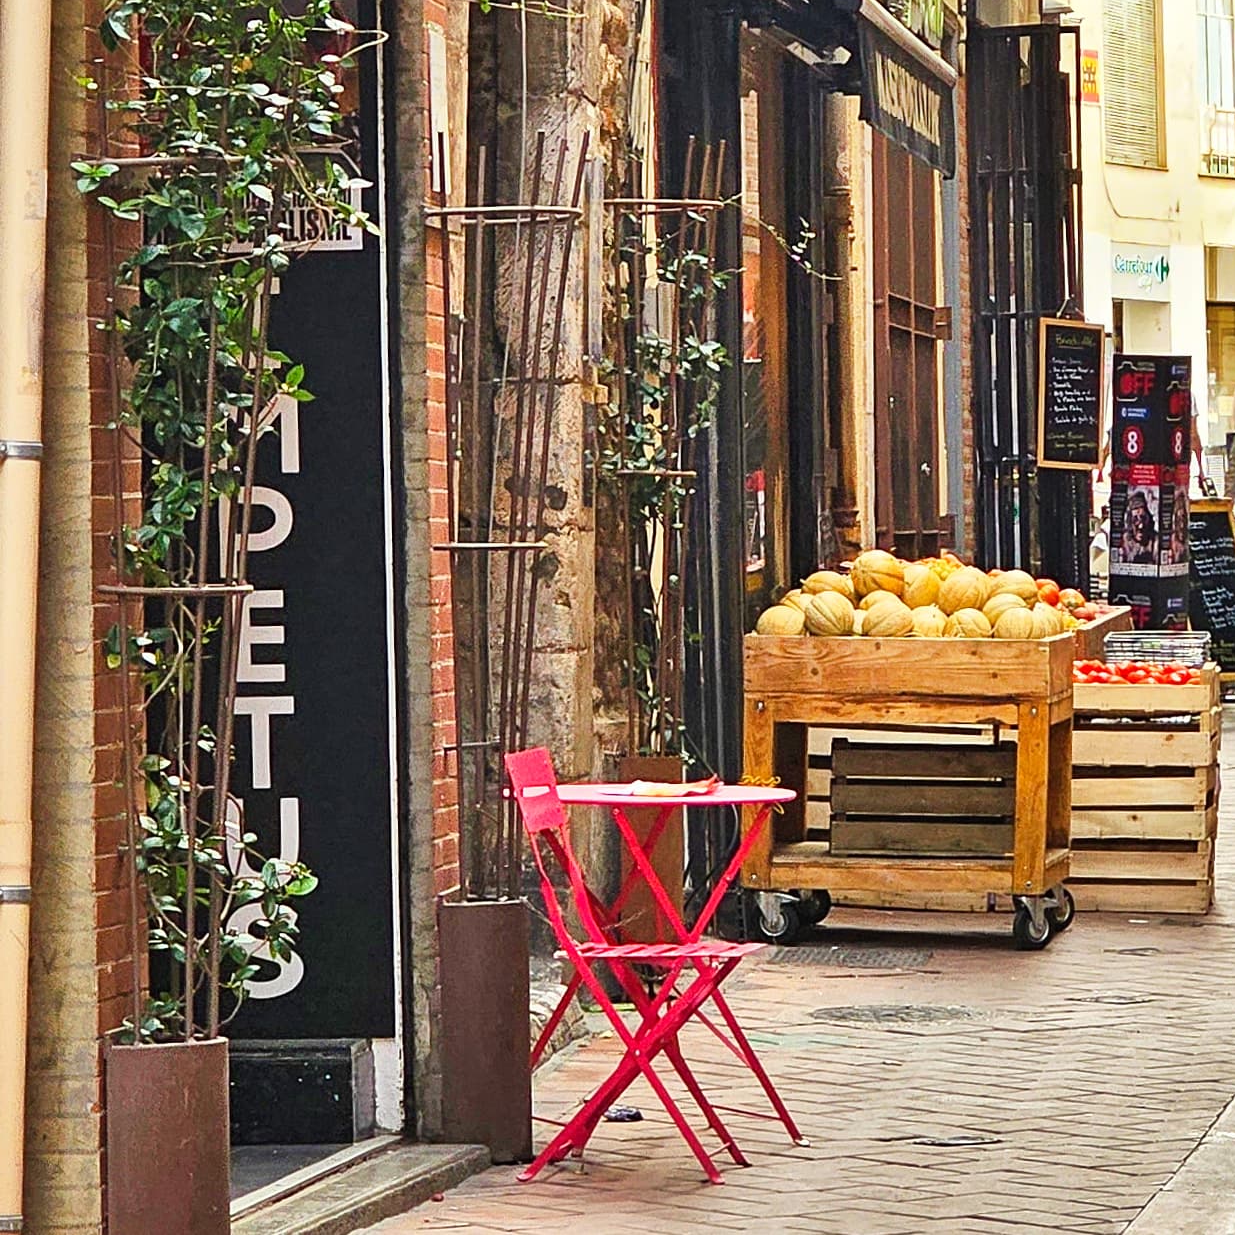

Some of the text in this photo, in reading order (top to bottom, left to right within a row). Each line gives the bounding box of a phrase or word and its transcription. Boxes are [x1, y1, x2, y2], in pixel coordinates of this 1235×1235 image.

[1114, 254, 1153, 274] Carrefour
[1127, 431, 1138, 454] 8
[1175, 431, 1182, 455] 8
